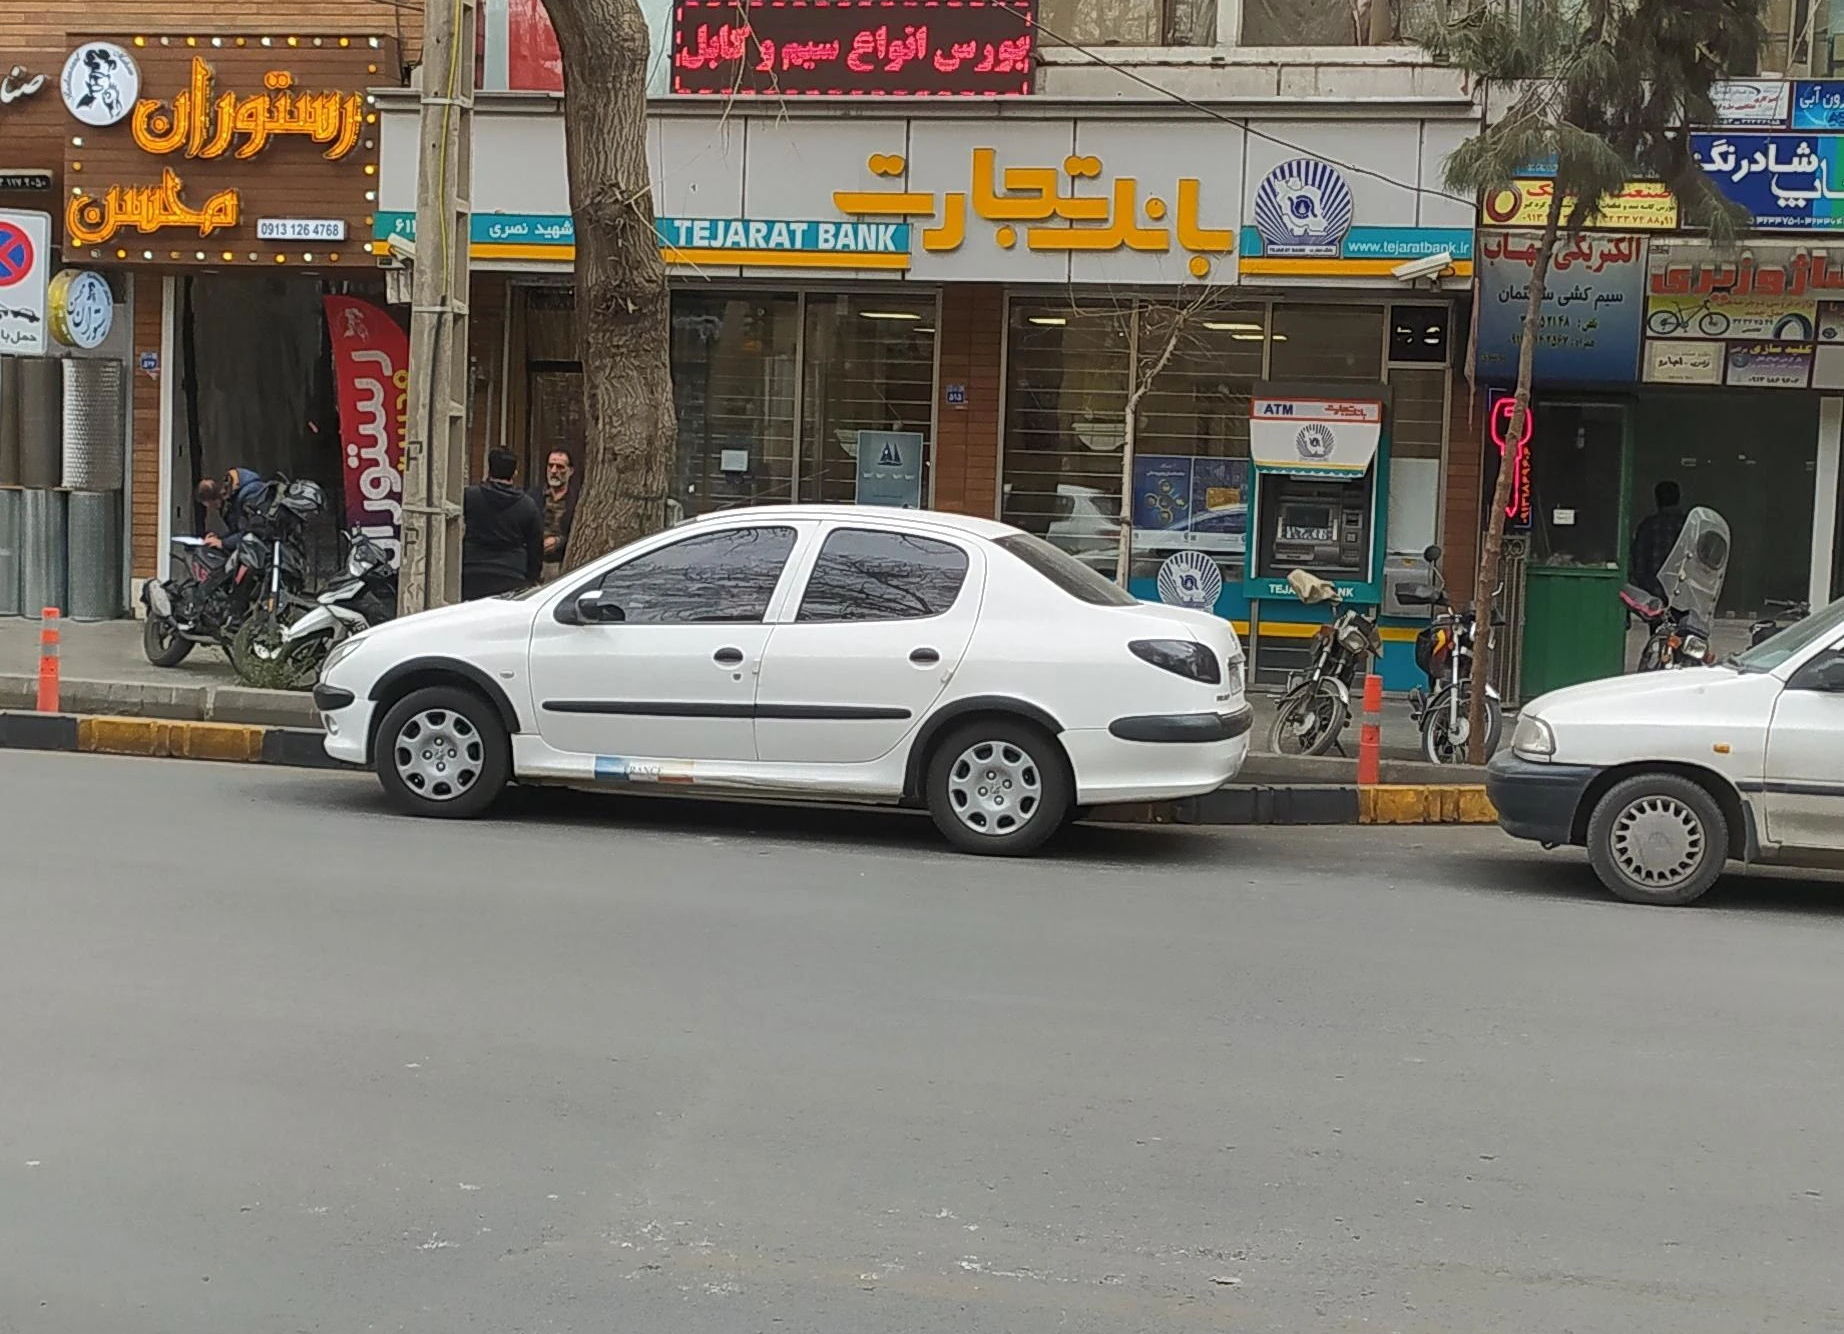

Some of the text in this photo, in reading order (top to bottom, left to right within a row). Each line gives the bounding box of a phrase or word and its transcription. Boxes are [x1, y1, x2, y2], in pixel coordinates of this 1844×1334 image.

[756, 38, 776, 71] و
[782, 39, 839, 71] سیم
[848, 25, 928, 72] انواع
[1799, 85, 1822, 109] آبی
[66, 56, 362, 245] رستوران محسن
[1694, 139, 1844, 208] اپ شادرنگ
[260, 222, 340, 237] 0913 126 4768
[489, 219, 574, 238] شهید نصری
[673, 219, 897, 252] TEJARAT BANK
[1348, 240, 1469, 255] www.tejaratbank.ir
[1483, 232, 1641, 273] الکتریکی هاب
[1498, 283, 1624, 311] سیم کشی ستمان
[10, 330, 38, 345] حمل
[1263, 403, 1294, 416] ATM
